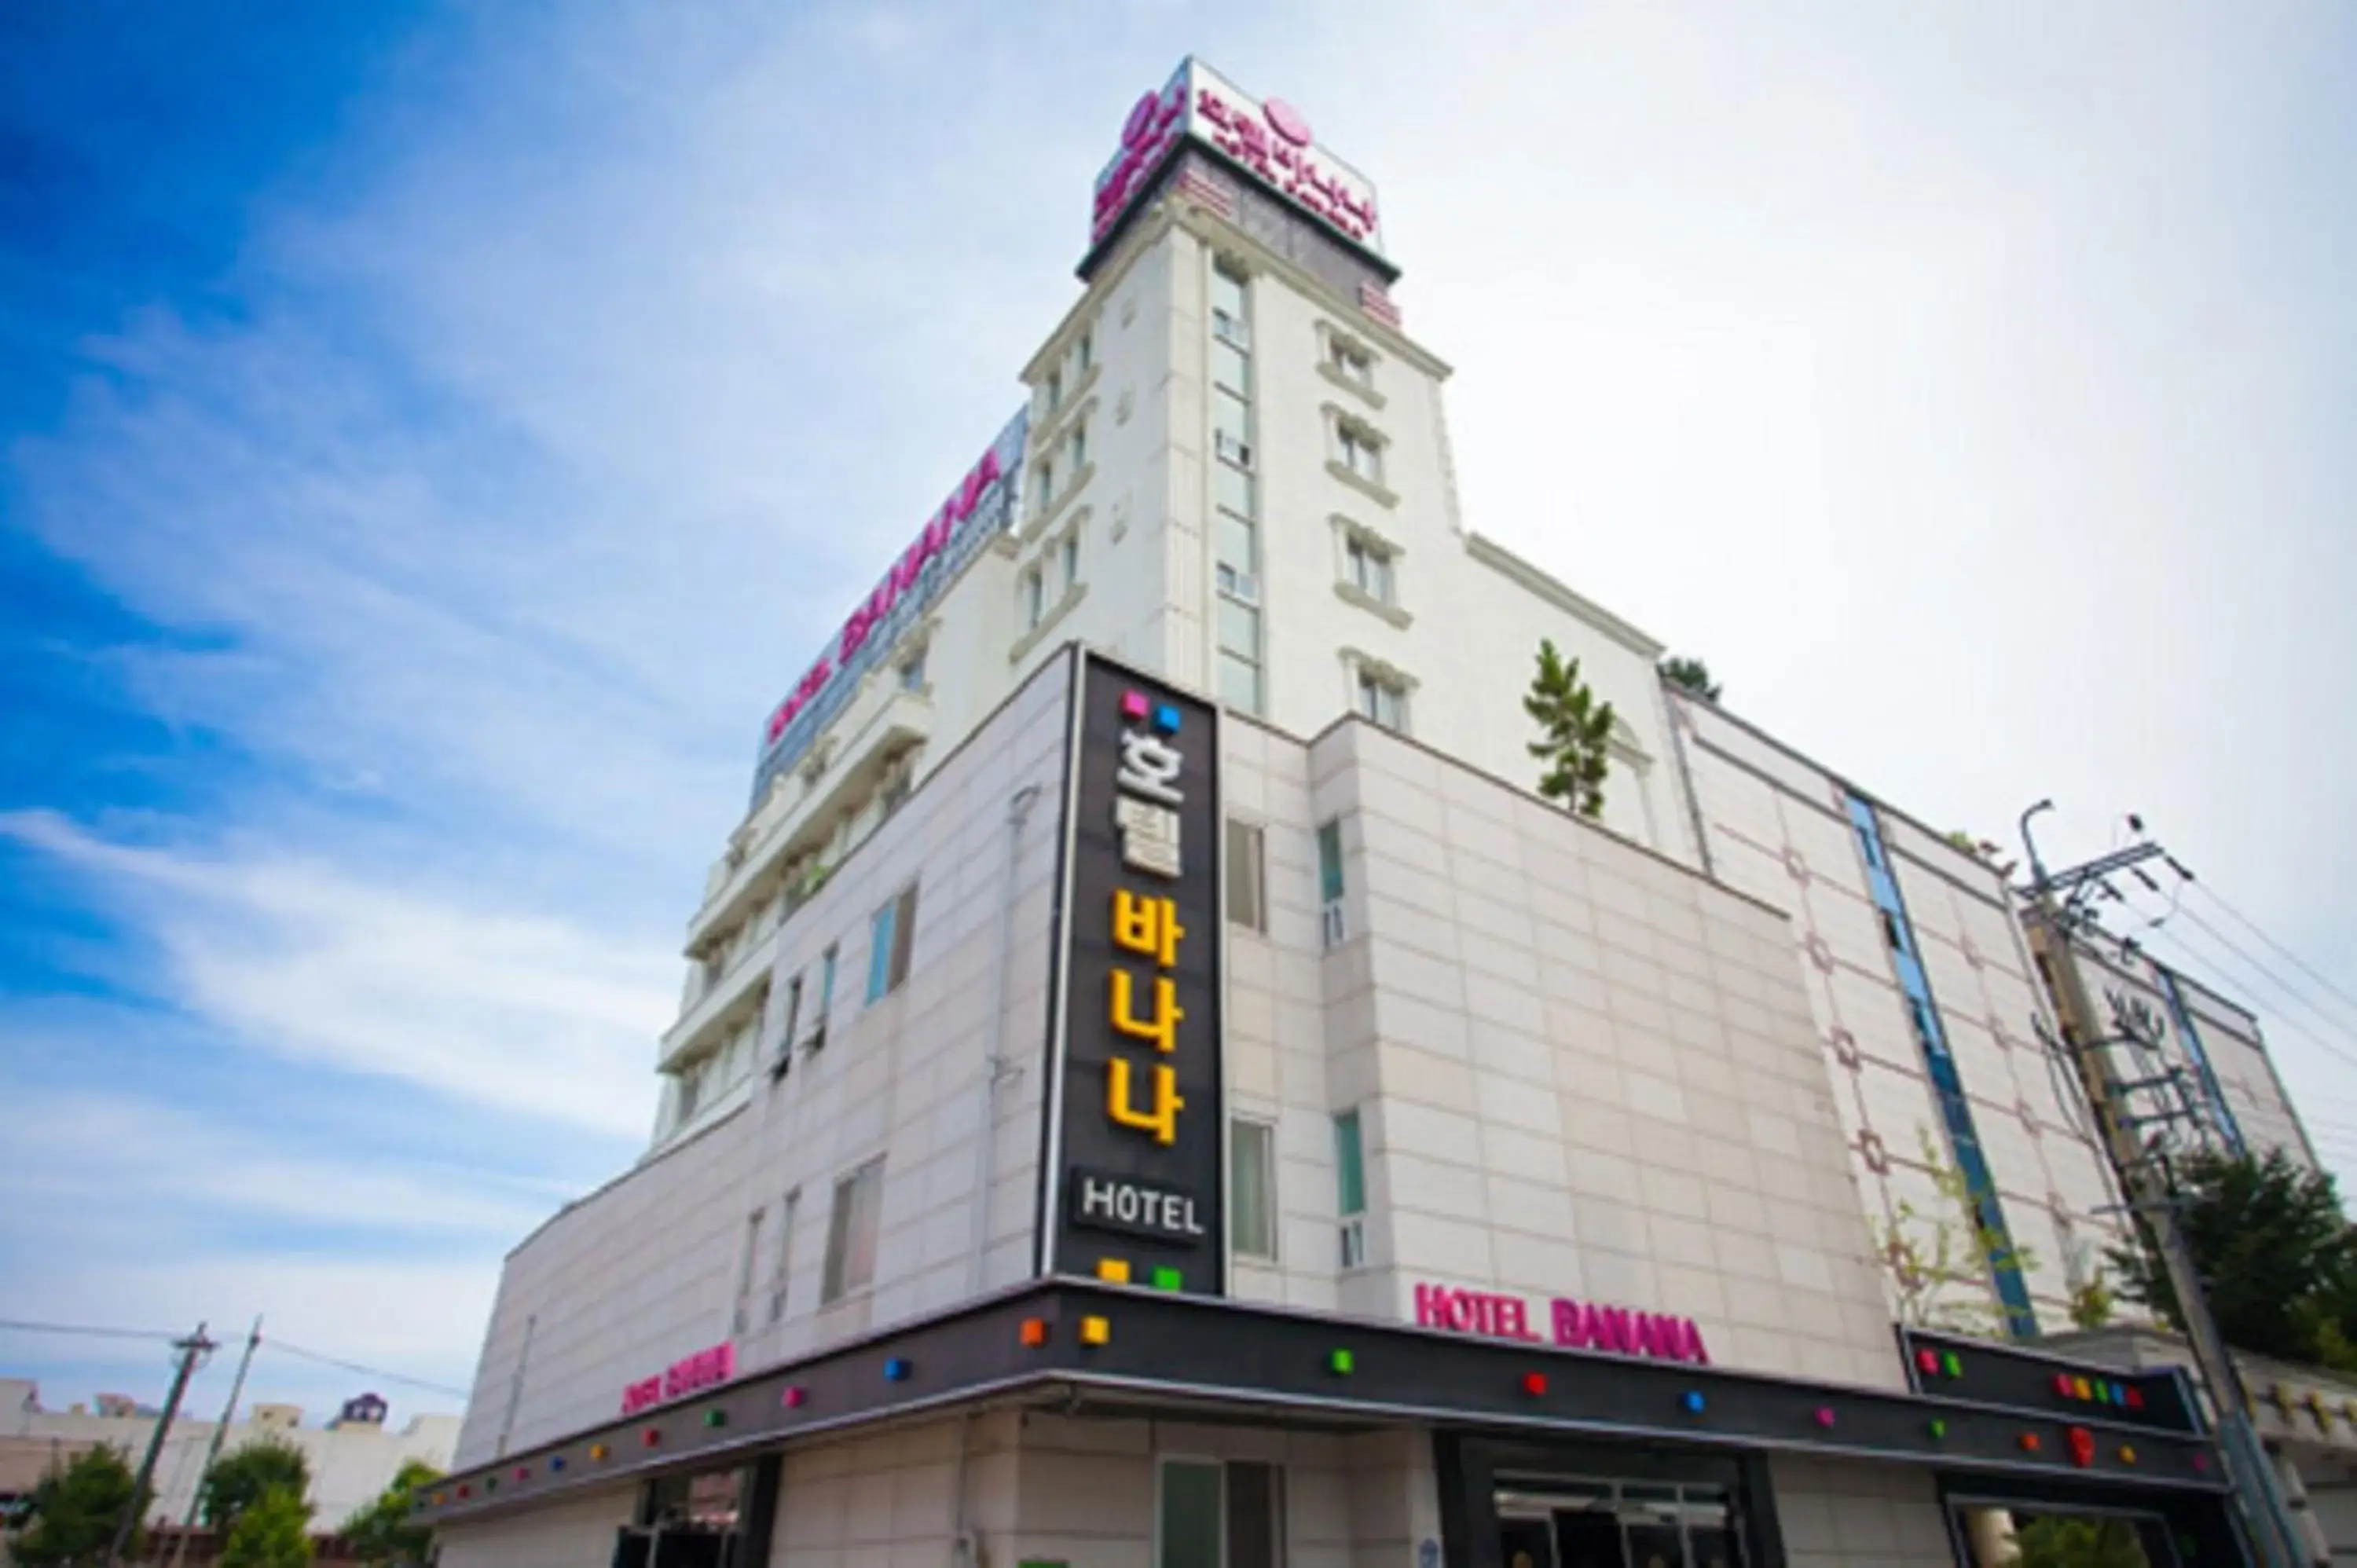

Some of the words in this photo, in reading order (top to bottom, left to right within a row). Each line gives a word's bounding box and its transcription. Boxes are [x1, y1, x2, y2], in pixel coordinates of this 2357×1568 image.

[1109, 888, 1186, 1145] 바나나
[1082, 1176, 1205, 1236] HOTEL
[1414, 1282, 1542, 1343] HOTEL
[1550, 1296, 1713, 1365] BANANA
